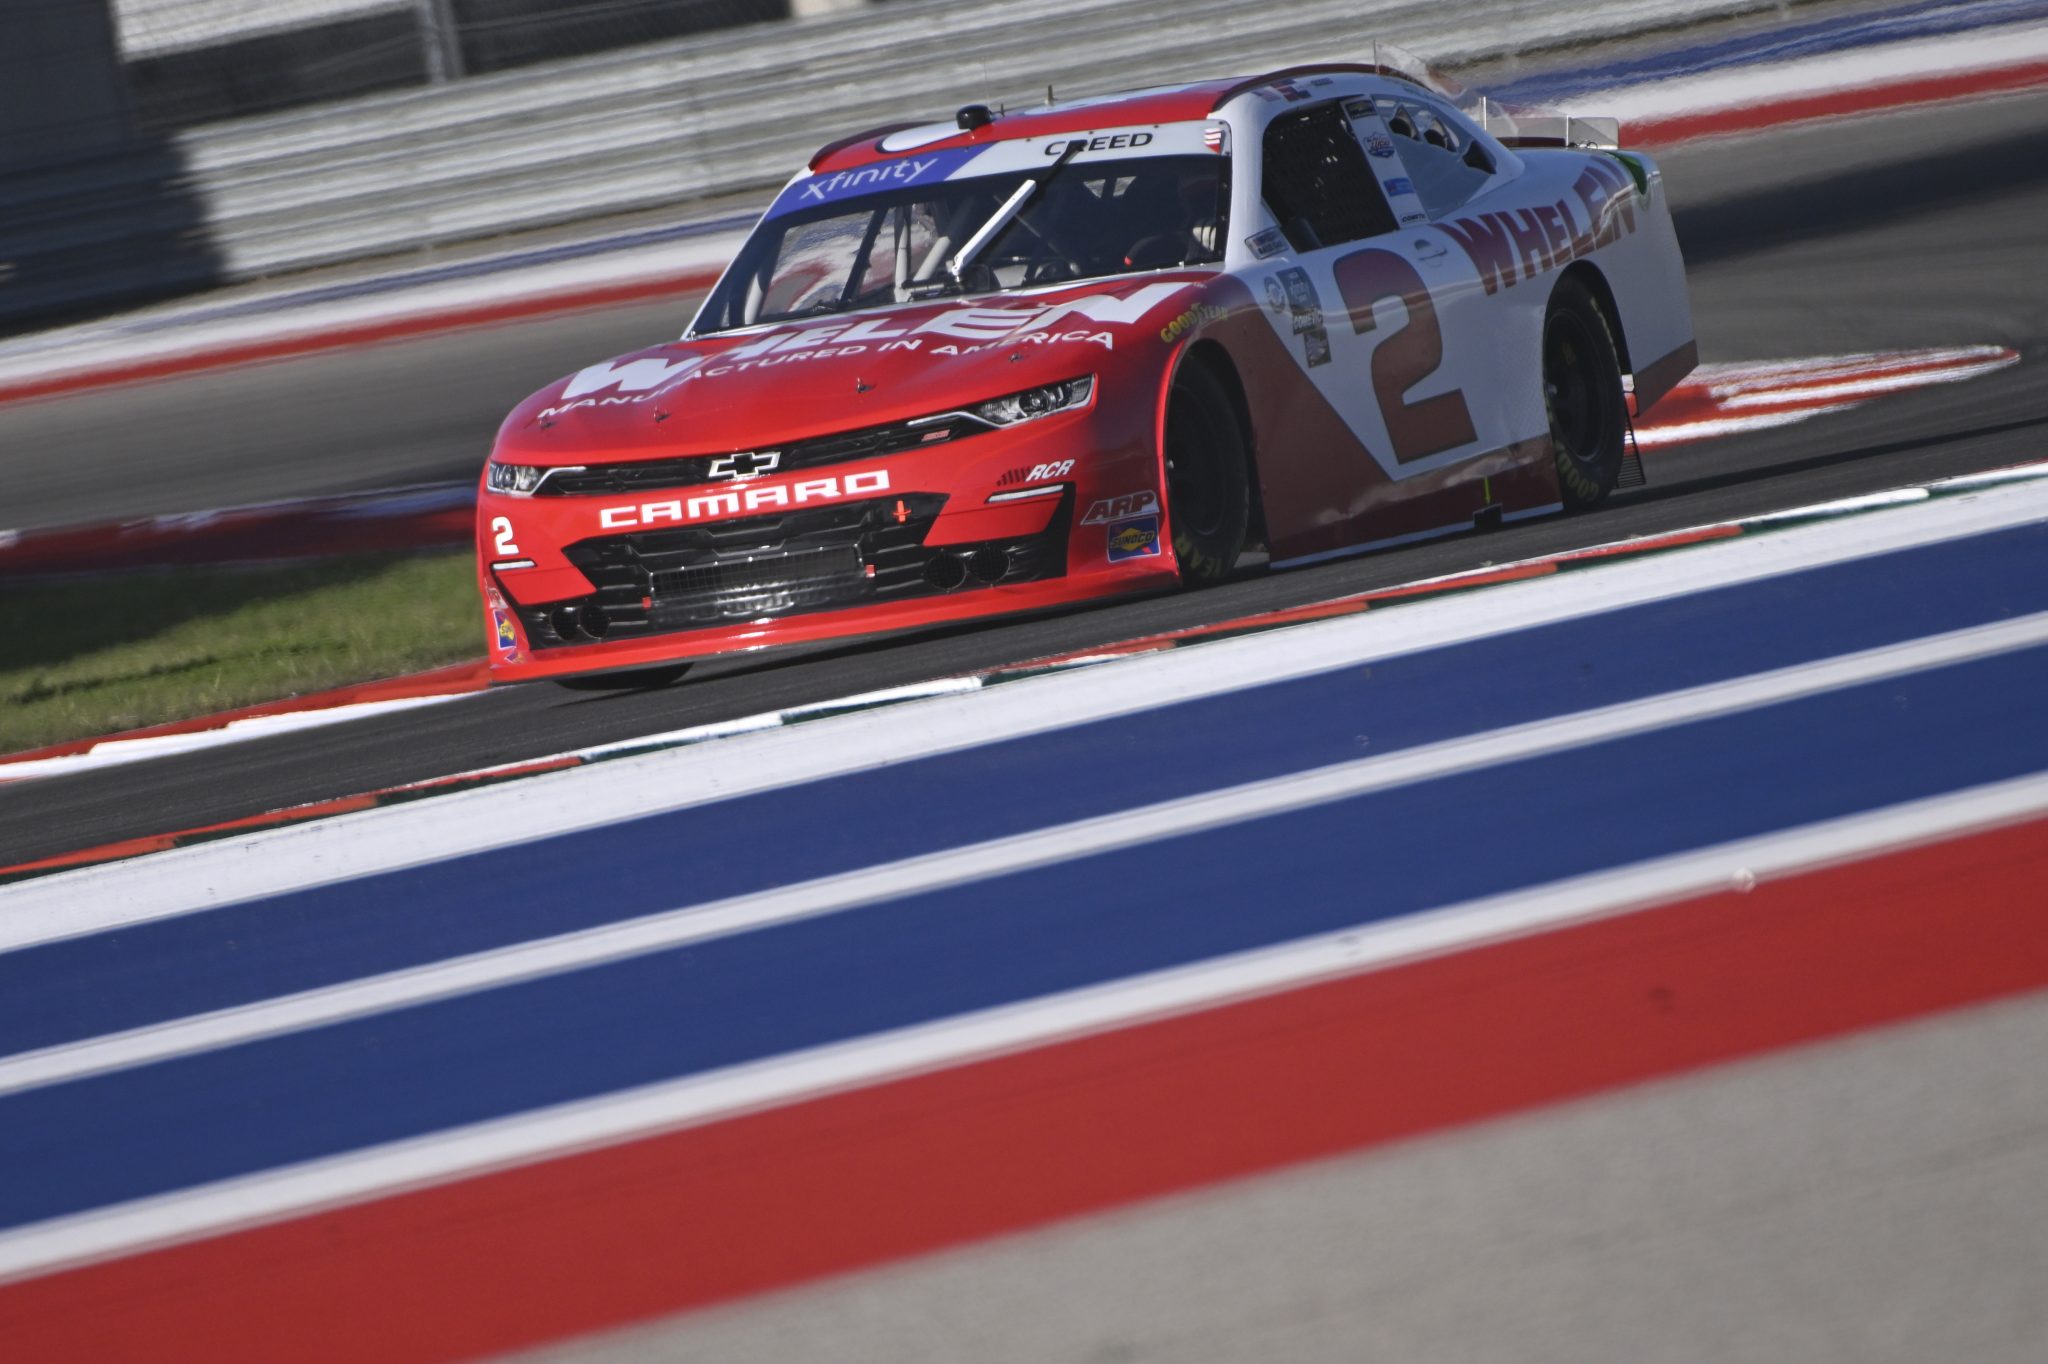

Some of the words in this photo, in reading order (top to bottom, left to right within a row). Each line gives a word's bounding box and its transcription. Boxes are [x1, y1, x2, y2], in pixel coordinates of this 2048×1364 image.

[800, 157, 939, 200] xfinity
[1428, 155, 1637, 297] WHELEN
[1332, 248, 1478, 465] 2
[537, 345, 867, 419] MANUACTURED
[878, 339, 923, 353] IN
[1025, 458, 1075, 482] RCR
[600, 469, 890, 529] CAMARO
[1080, 489, 1160, 526] ARP
[491, 515, 520, 555] 2
[1110, 530, 1155, 551] SUNOCO
